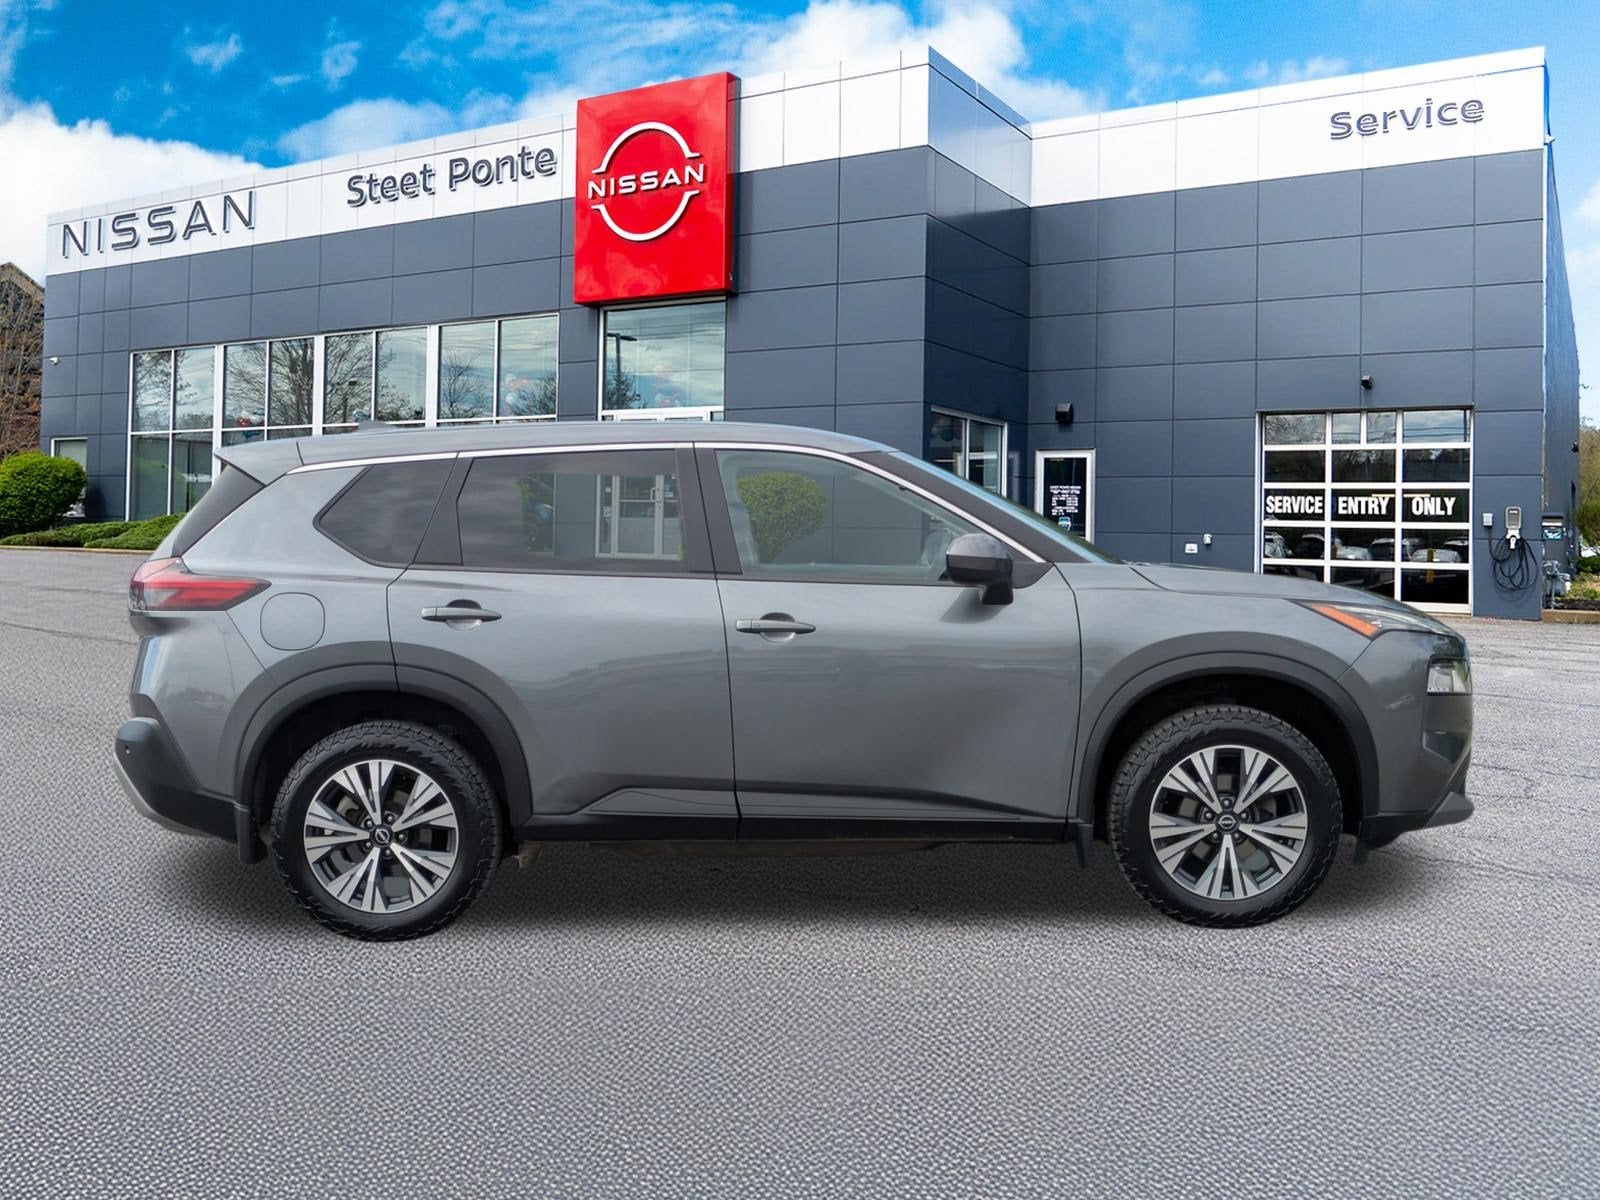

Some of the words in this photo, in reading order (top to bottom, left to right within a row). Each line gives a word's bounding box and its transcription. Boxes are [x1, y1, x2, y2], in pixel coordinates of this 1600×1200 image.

[1330, 98, 1484, 140] Service
[347, 163, 436, 207] Steet
[449, 145, 557, 191] Ponte
[587, 163, 705, 199] NISSAN
[62, 191, 256, 259] NISSAN
[1266, 495, 1323, 514] SERVICE
[1337, 496, 1390, 516] ENTRY
[1411, 496, 1456, 516] ONLY
